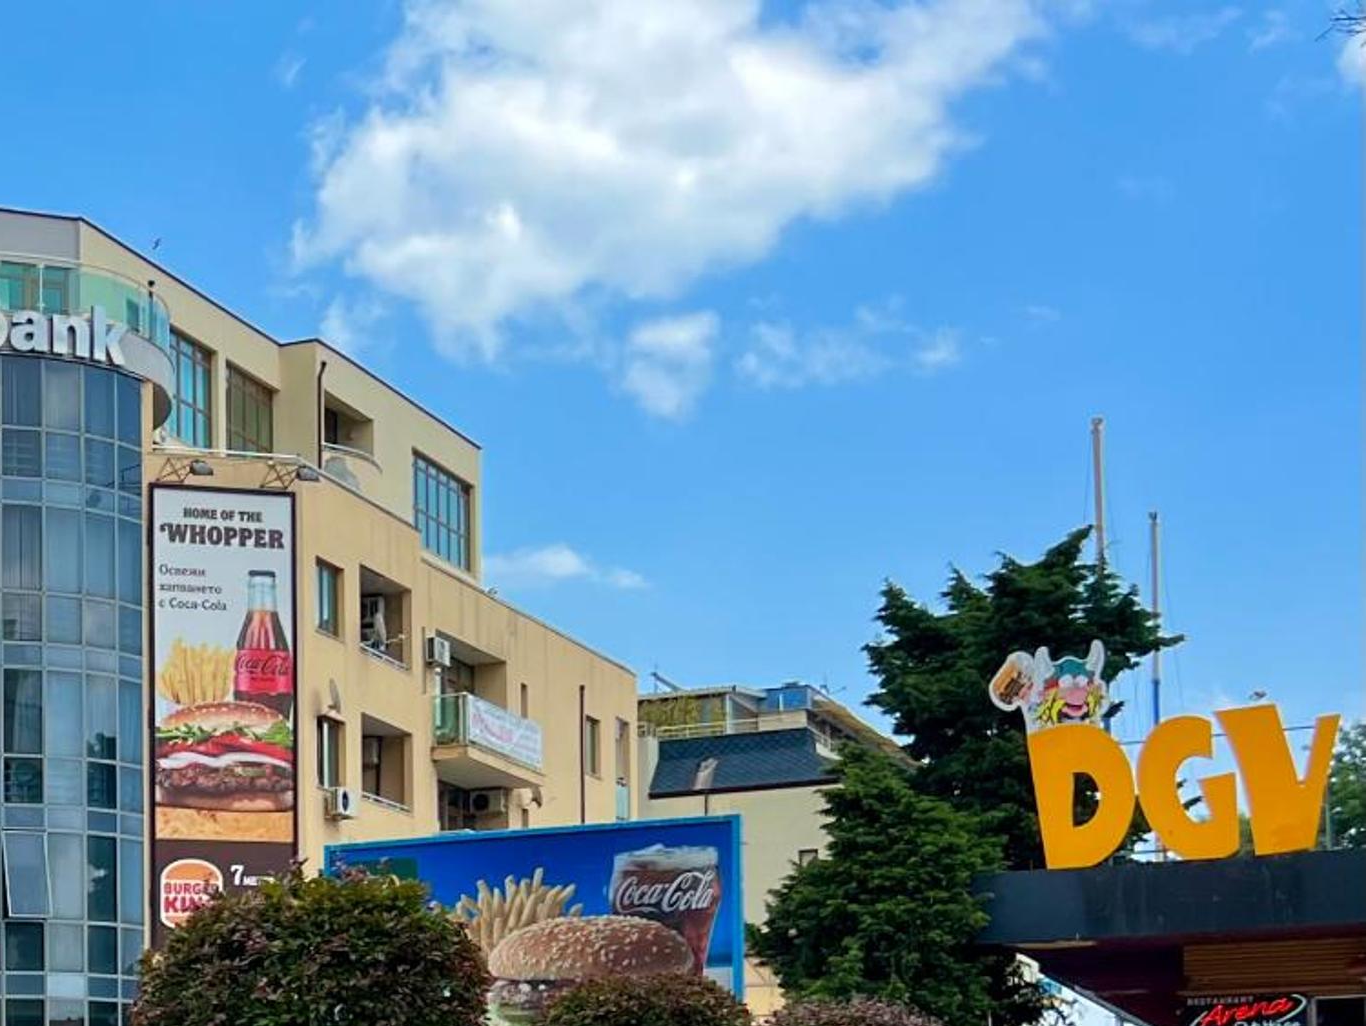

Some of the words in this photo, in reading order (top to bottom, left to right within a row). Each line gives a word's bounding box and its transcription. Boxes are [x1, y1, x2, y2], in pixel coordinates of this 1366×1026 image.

[184, 507, 217, 520] HOME
[220, 509, 235, 522] OF
[239, 511, 263, 523] THE
[159, 523, 285, 549] WHOPPER
[169, 597, 227, 611] Coca-Cola
[1029, 704, 1341, 870] DGV
